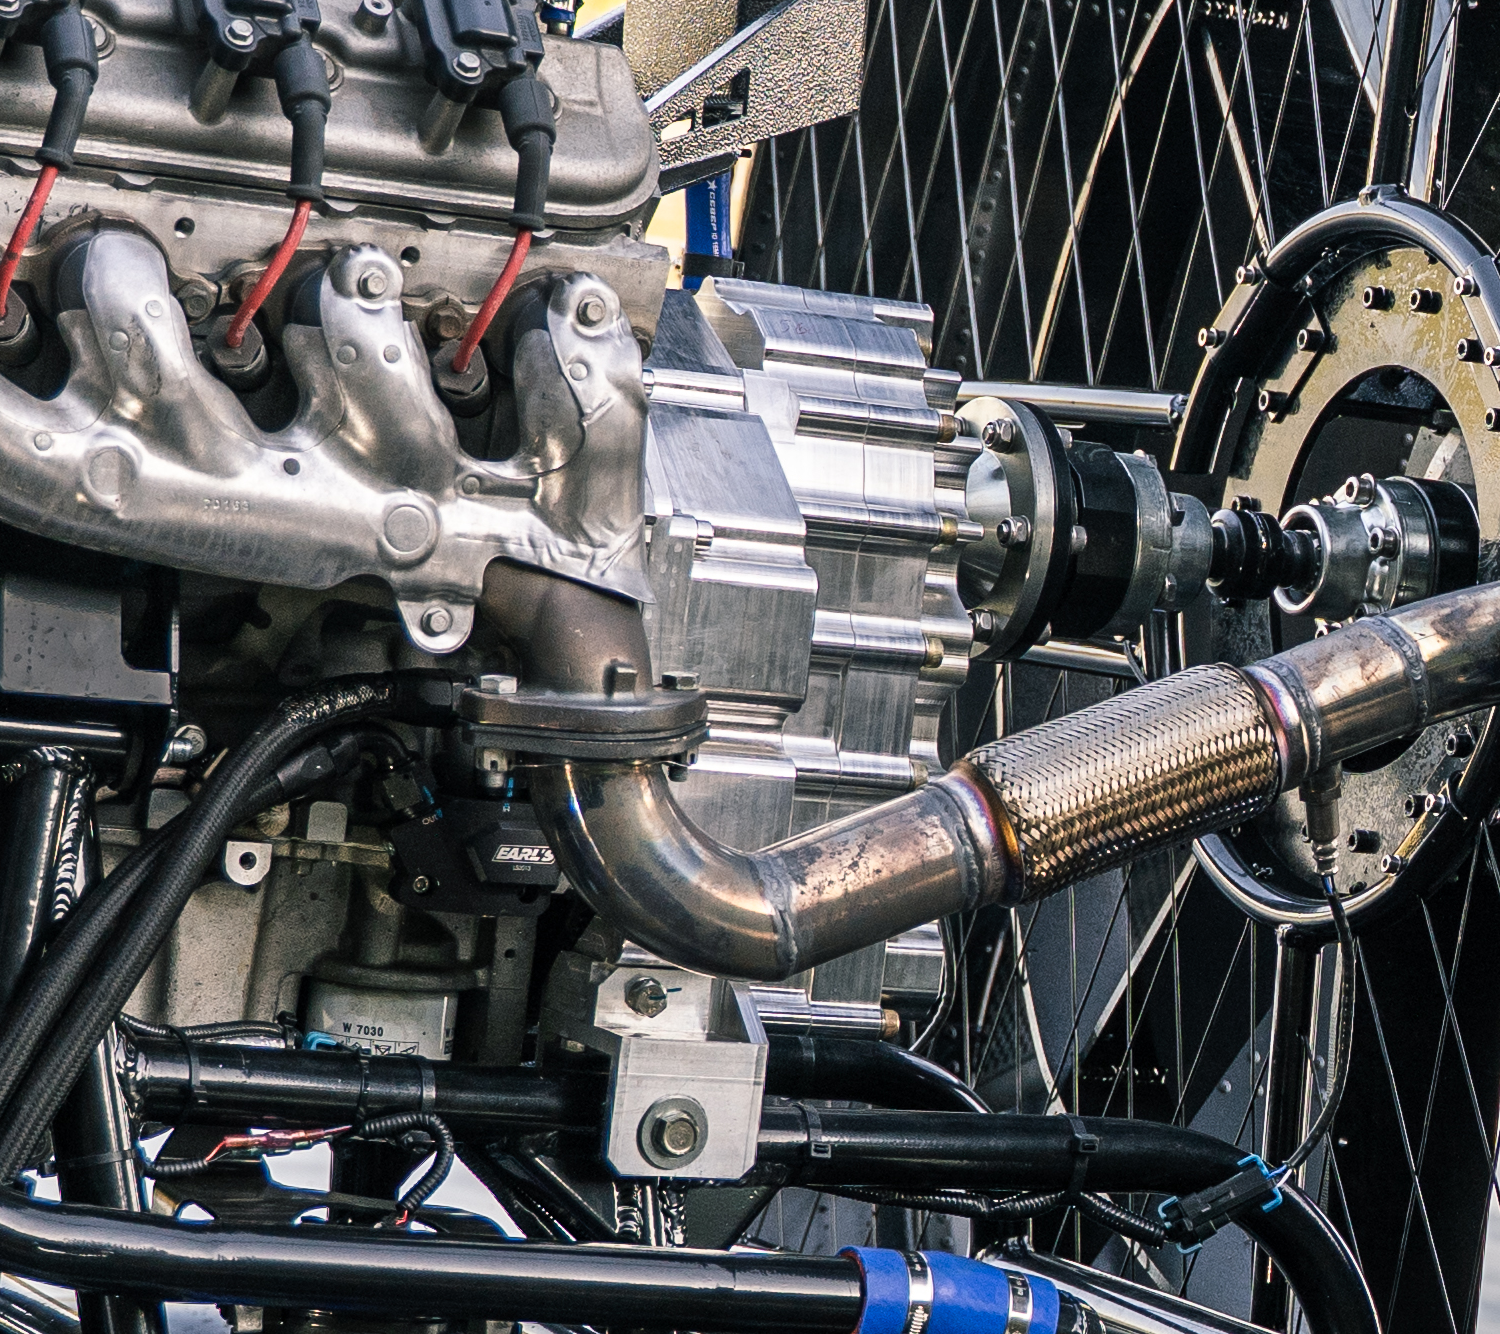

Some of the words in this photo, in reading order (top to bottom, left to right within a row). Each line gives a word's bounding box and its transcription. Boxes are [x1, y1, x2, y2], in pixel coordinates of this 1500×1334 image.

[495, 846, 555, 862] EARL'S
[342, 1022, 352, 1033] W
[356, 1024, 384, 1037] 7030
